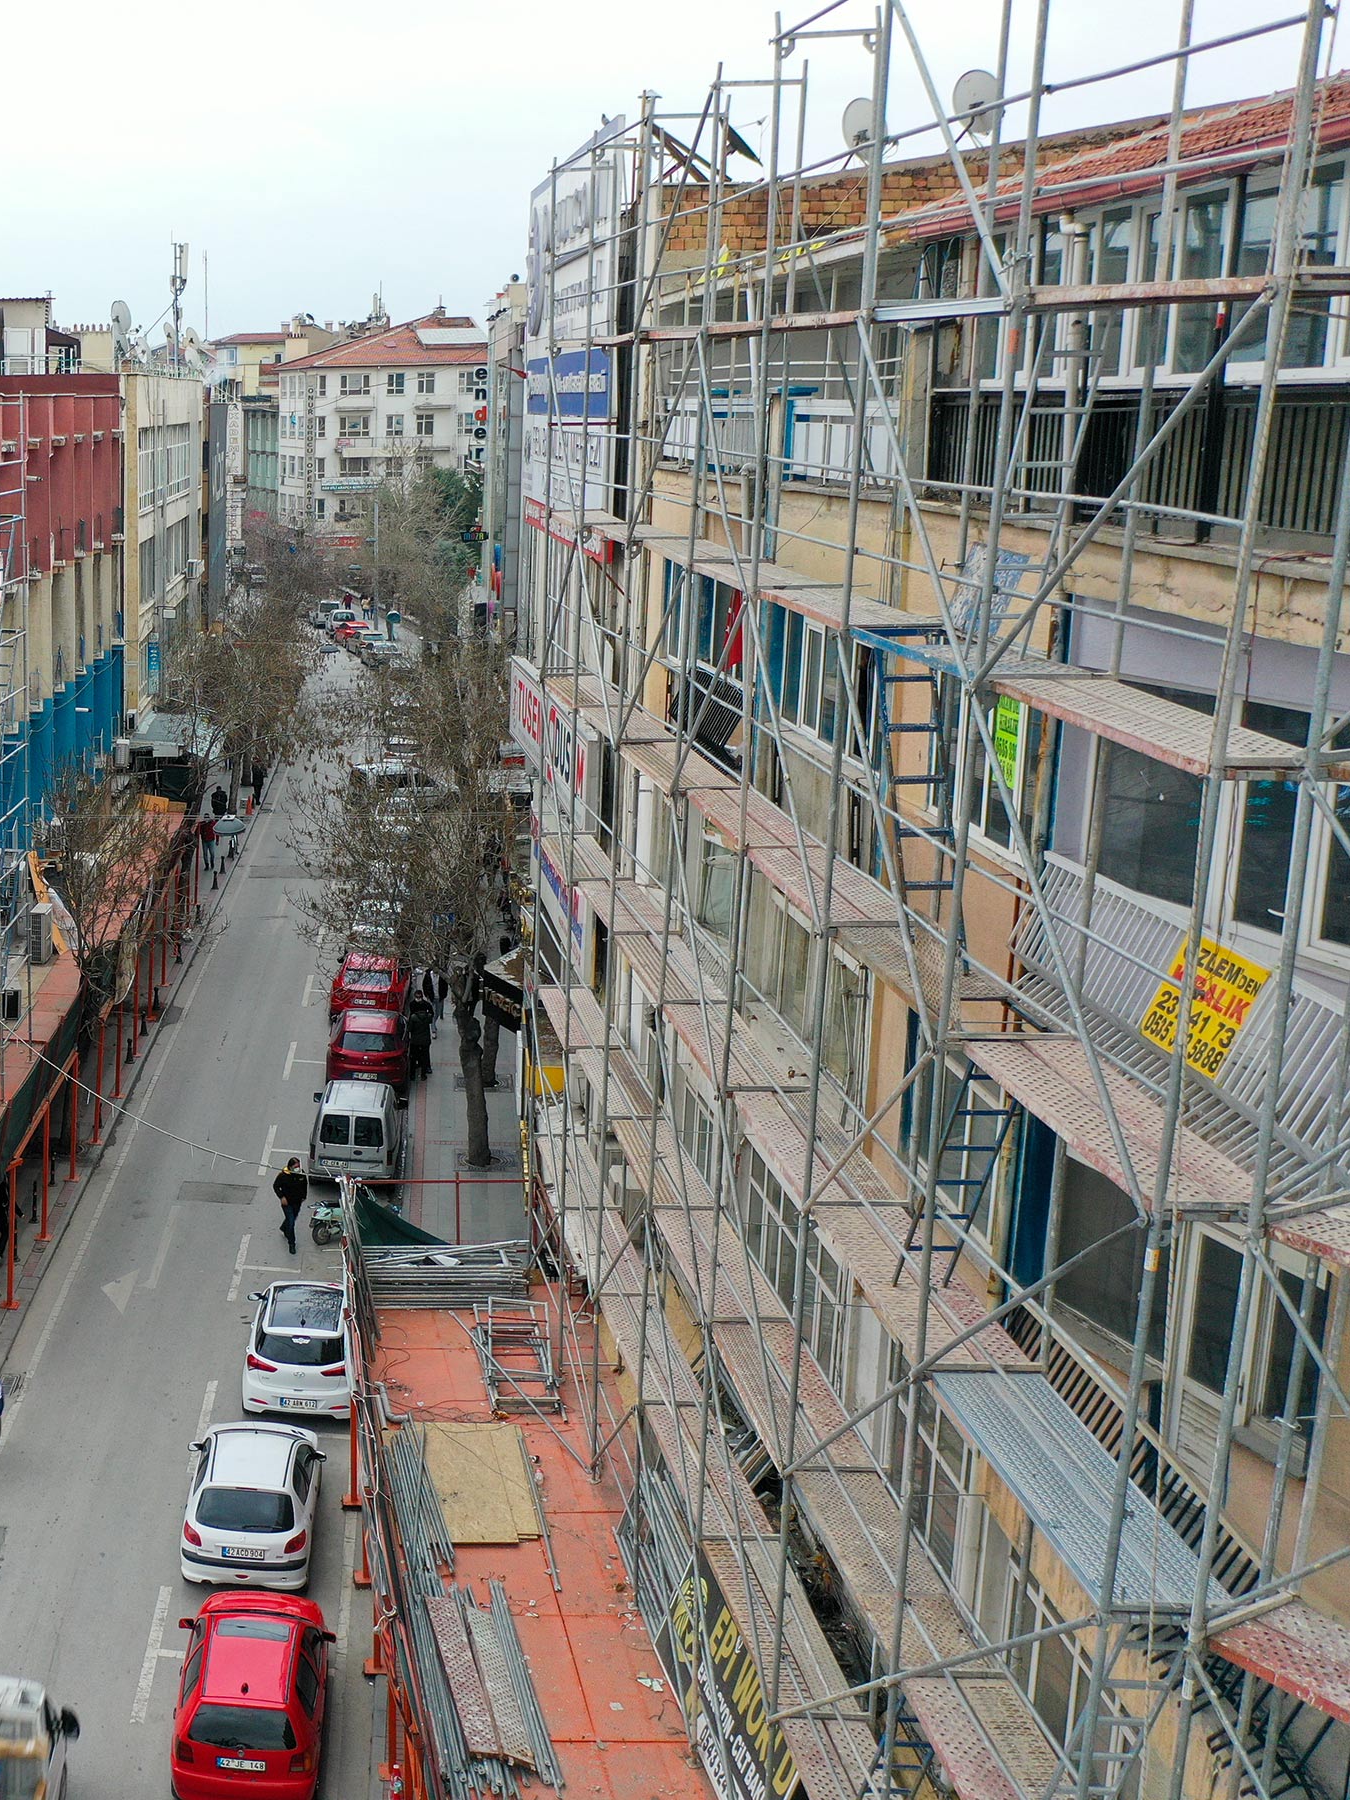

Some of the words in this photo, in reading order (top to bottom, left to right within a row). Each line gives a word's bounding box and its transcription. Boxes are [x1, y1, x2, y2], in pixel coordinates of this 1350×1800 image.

[1183, 946, 1262, 998] ZLEM'DEN
[1172, 963, 1251, 1026] KRALIK
[1211, 1021, 1236, 1049] 73
[234, 1760, 245, 1768] JE
[250, 1762, 265, 1770] 148
